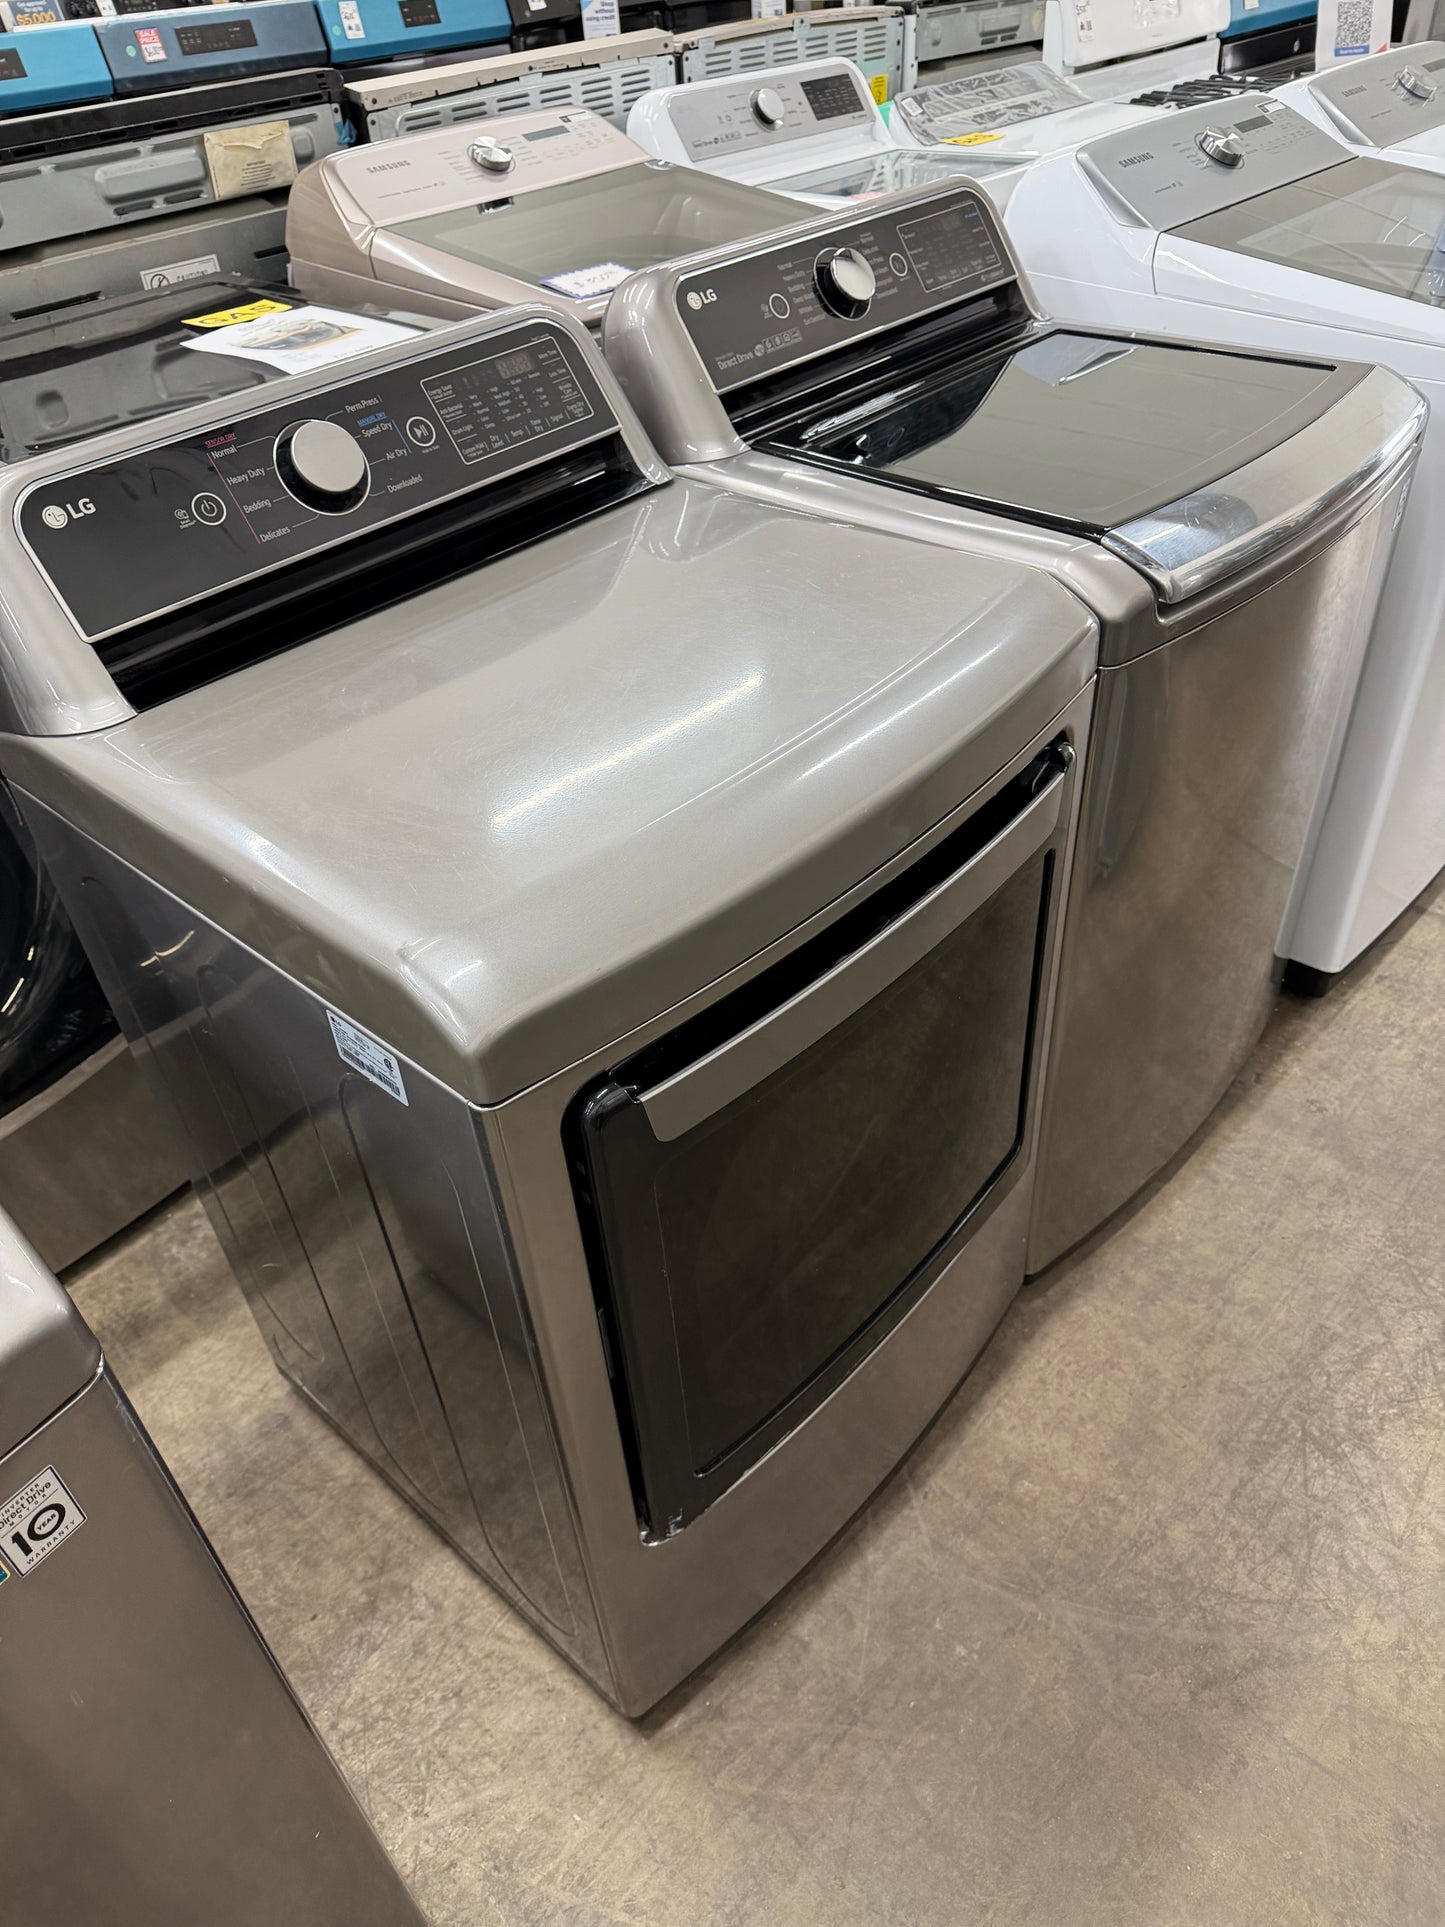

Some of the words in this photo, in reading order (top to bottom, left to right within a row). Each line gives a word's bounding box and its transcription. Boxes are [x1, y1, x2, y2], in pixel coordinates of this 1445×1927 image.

[366, 160, 411, 174] SAMSUNG
[1118, 152, 1154, 168] SAMSUNG
[700, 288, 718, 304] LG
[197, 303, 278, 325] GAS
[717, 357, 738, 371] Direct
[736, 351, 754, 364] Drive
[361, 424, 382, 438] Speed
[380, 421, 393, 431] Dry
[211, 444, 237, 459] Normal
[386, 450, 395, 461] Air
[395, 448, 408, 456] Dry
[226, 472, 249, 485] Heavy
[248, 467, 265, 478] Duty
[387, 473, 423, 493] Downloaded
[66, 498, 97, 519] LG
[243, 498, 272, 514] Bedding
[259, 526, 291, 542] Delicates
[0, 1502, 27, 1530] Direct
[26, 1481, 52, 1504] Drive
[1, 1483, 40, 1517] INVERTER
[9, 1493, 47, 1528] MOTOR
[11, 1502, 66, 1557] 10
[37, 1512, 57, 1531] YEAR
[26, 1519, 76, 1565] WARRANTY
